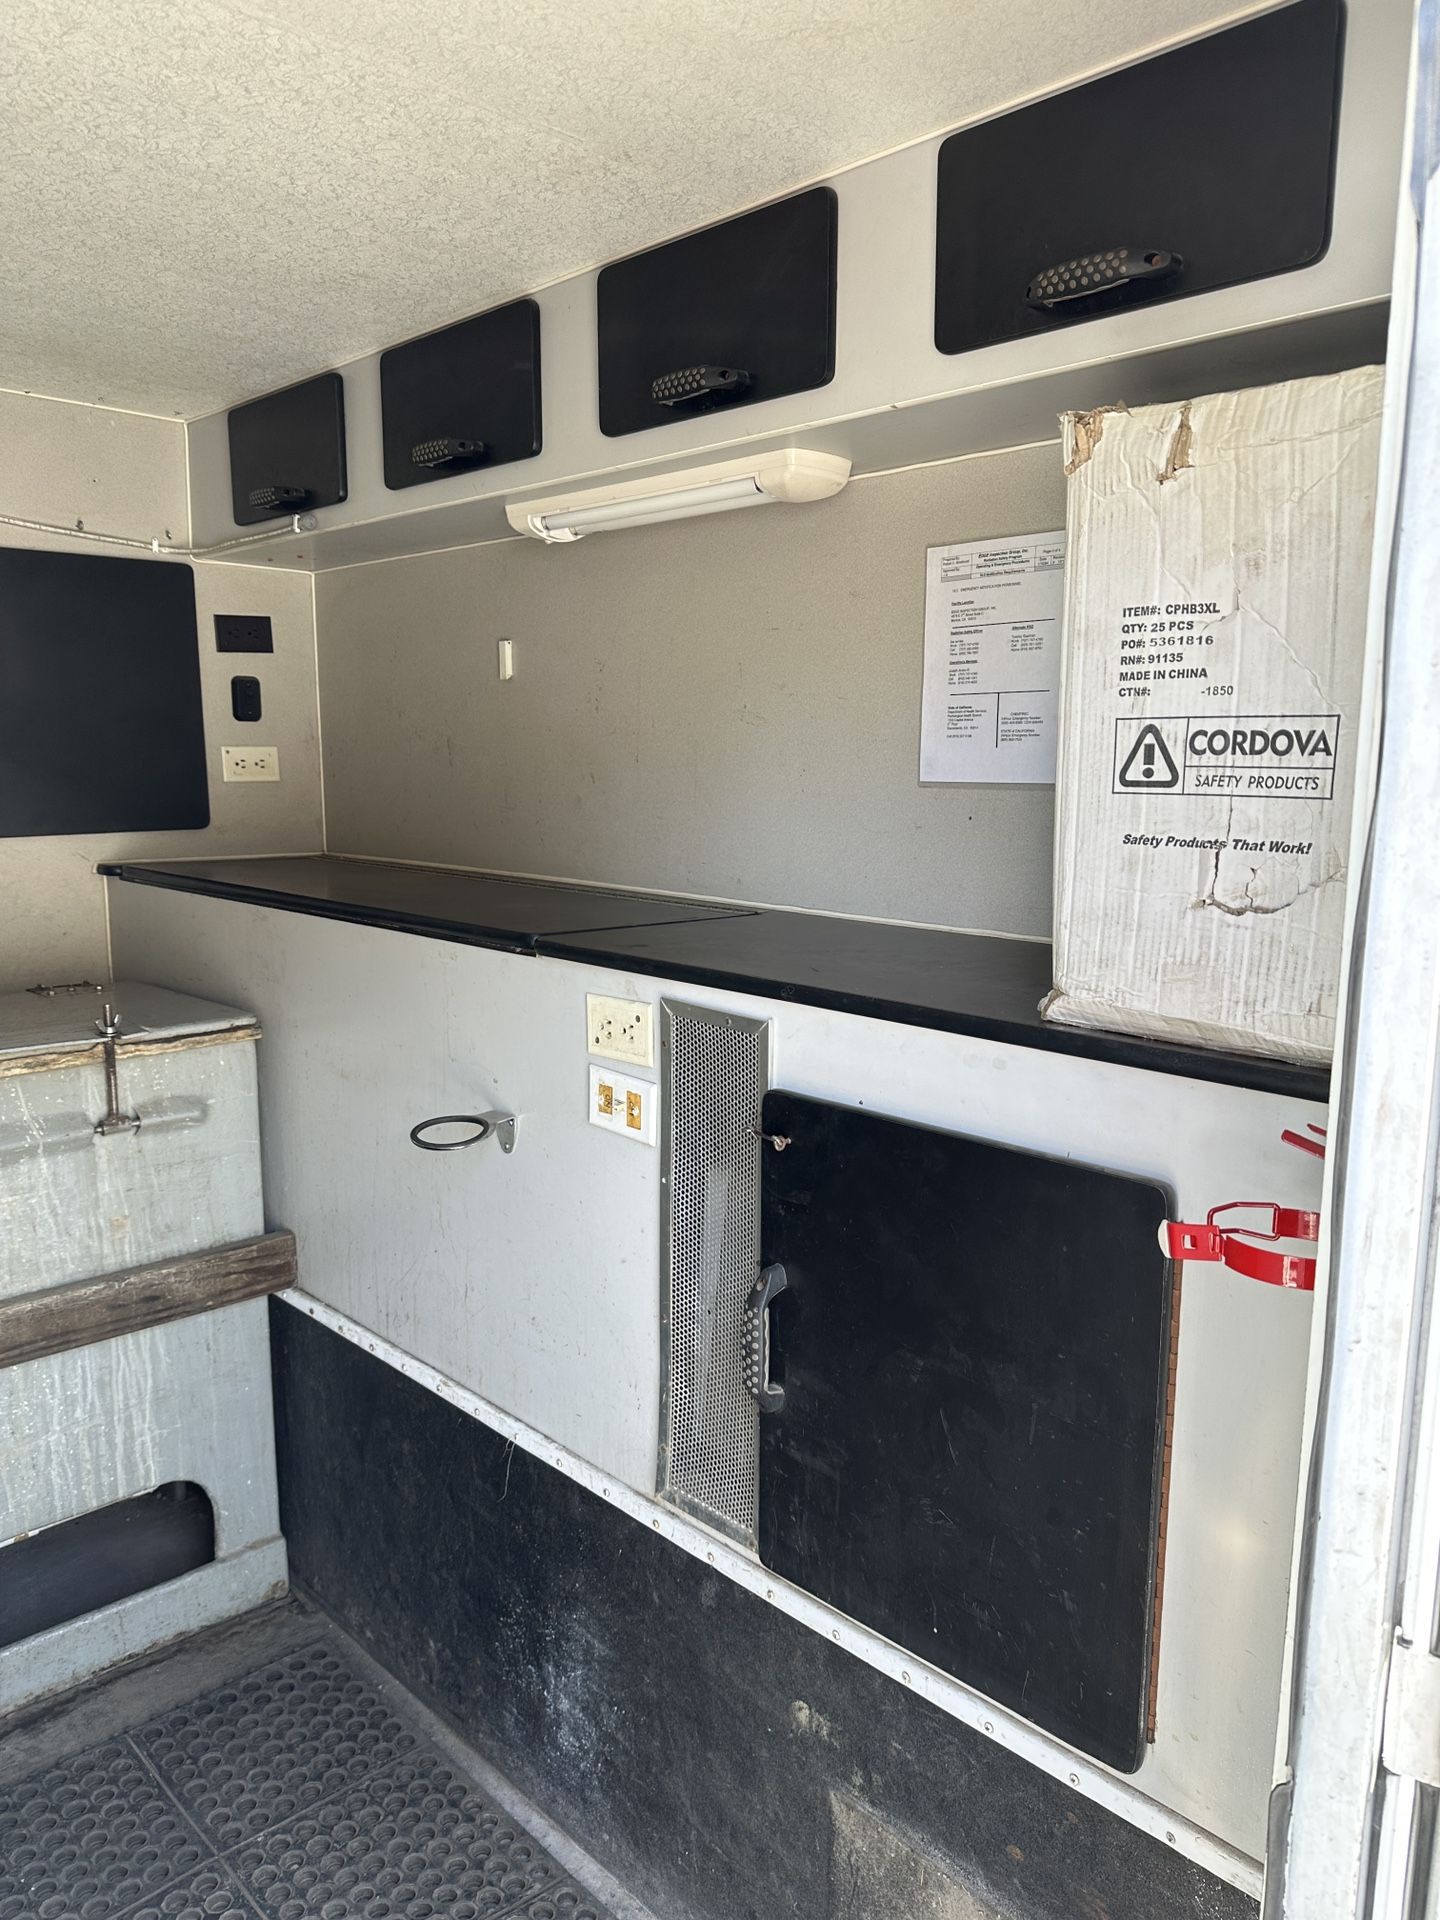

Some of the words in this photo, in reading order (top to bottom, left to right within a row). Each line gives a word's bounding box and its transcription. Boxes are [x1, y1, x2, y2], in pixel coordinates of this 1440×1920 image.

[1122, 606, 1161, 618] ITEM#:
[1165, 602, 1220, 615] CPHB3XL
[1122, 623, 1147, 634] QTY:
[1150, 622, 1166, 633] 25
[1169, 620, 1194, 631] PCS
[1121, 639, 1146, 649] PO#:
[1149, 635, 1214, 647] 5361816
[1120, 655, 1145, 666] RN#:
[1148, 652, 1183, 664] 91135
[1119, 670, 1151, 681] MADE
[1153, 670, 1166, 680] IN
[1168, 668, 1208, 679] CHINA
[1118, 687, 1151, 697] CTN#:
[1201, 685, 1234, 696] -1850
[1189, 729, 1333, 757] CORDOVA
[1195, 774, 1242, 788] SAFETY
[1247, 775, 1320, 791] PRODUCTS
[1122, 834, 1163, 847] Safety
[1165, 836, 1227, 850] Products
[1232, 838, 1266, 852] That
[1269, 841, 1313, 855] Work!
